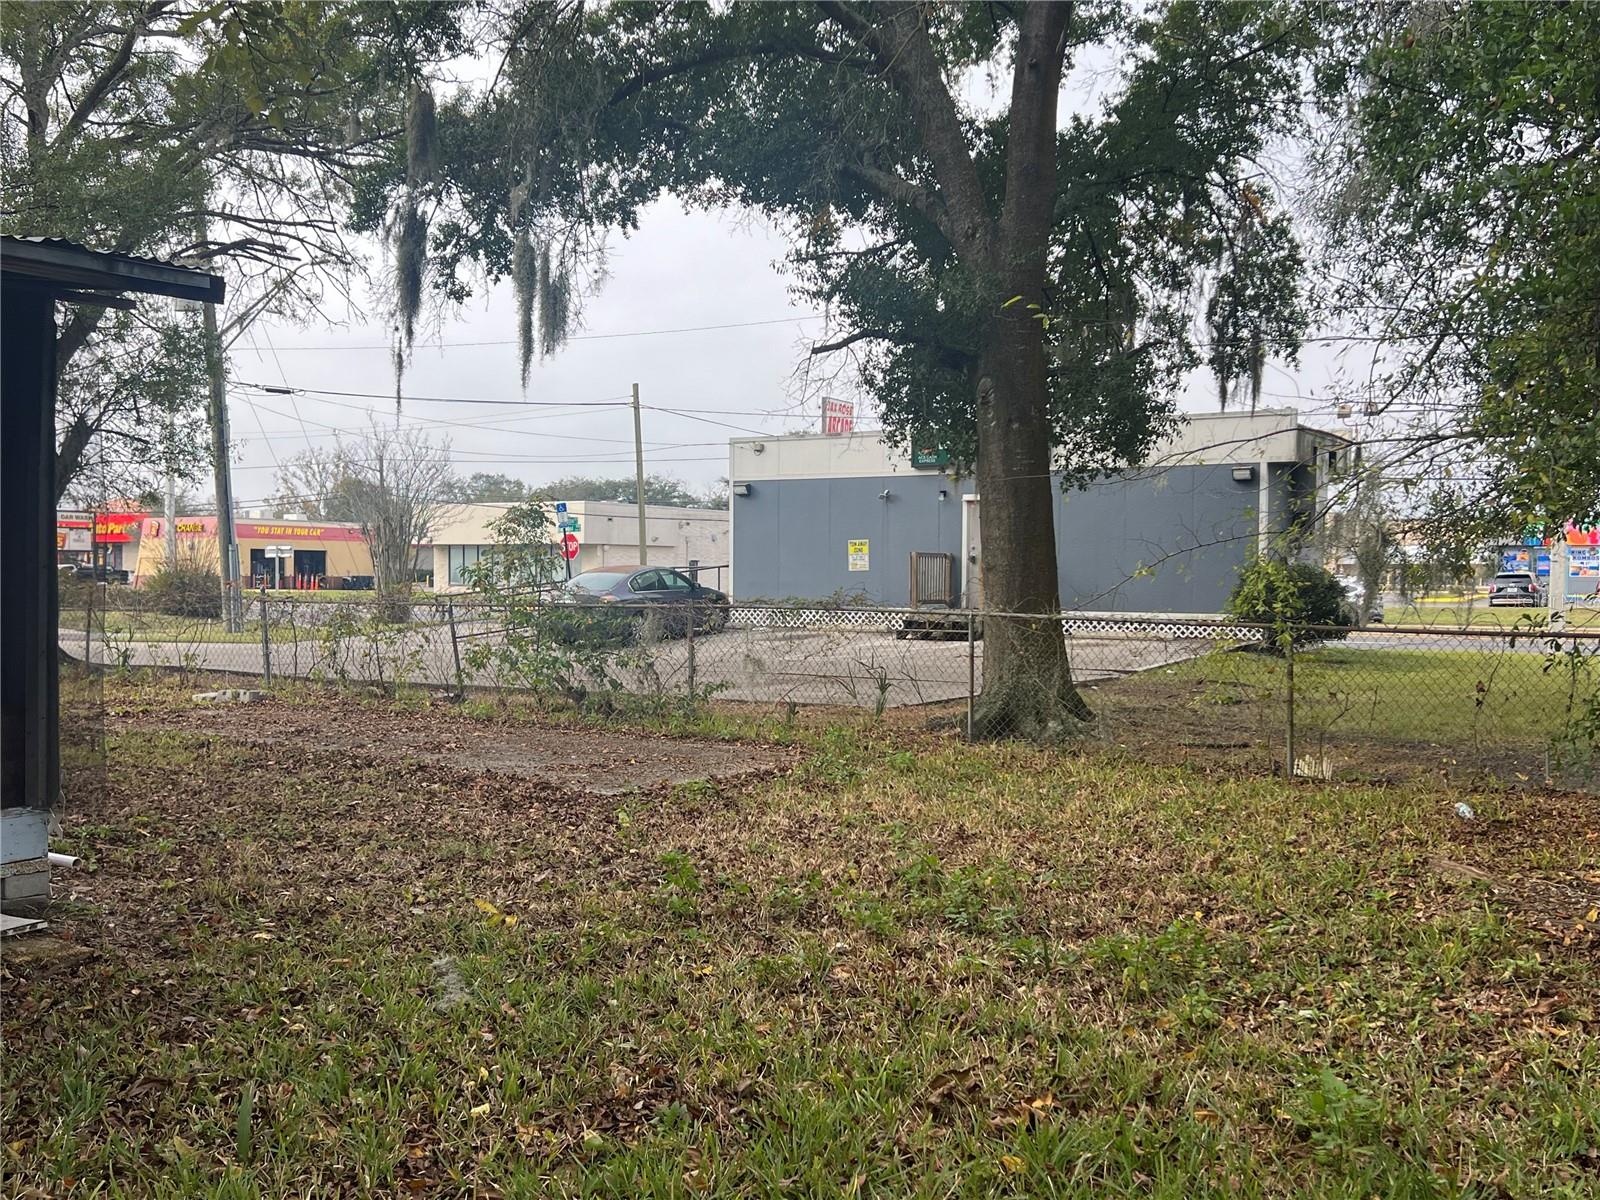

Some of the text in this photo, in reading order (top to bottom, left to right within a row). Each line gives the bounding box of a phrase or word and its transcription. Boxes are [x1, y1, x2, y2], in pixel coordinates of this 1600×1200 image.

[828, 416, 853, 432] ARCADE
[177, 523, 204, 532] CHANGE
[270, 527, 285, 535] STAY
[286, 527, 292, 535] IN
[294, 528, 309, 536] YOUR
